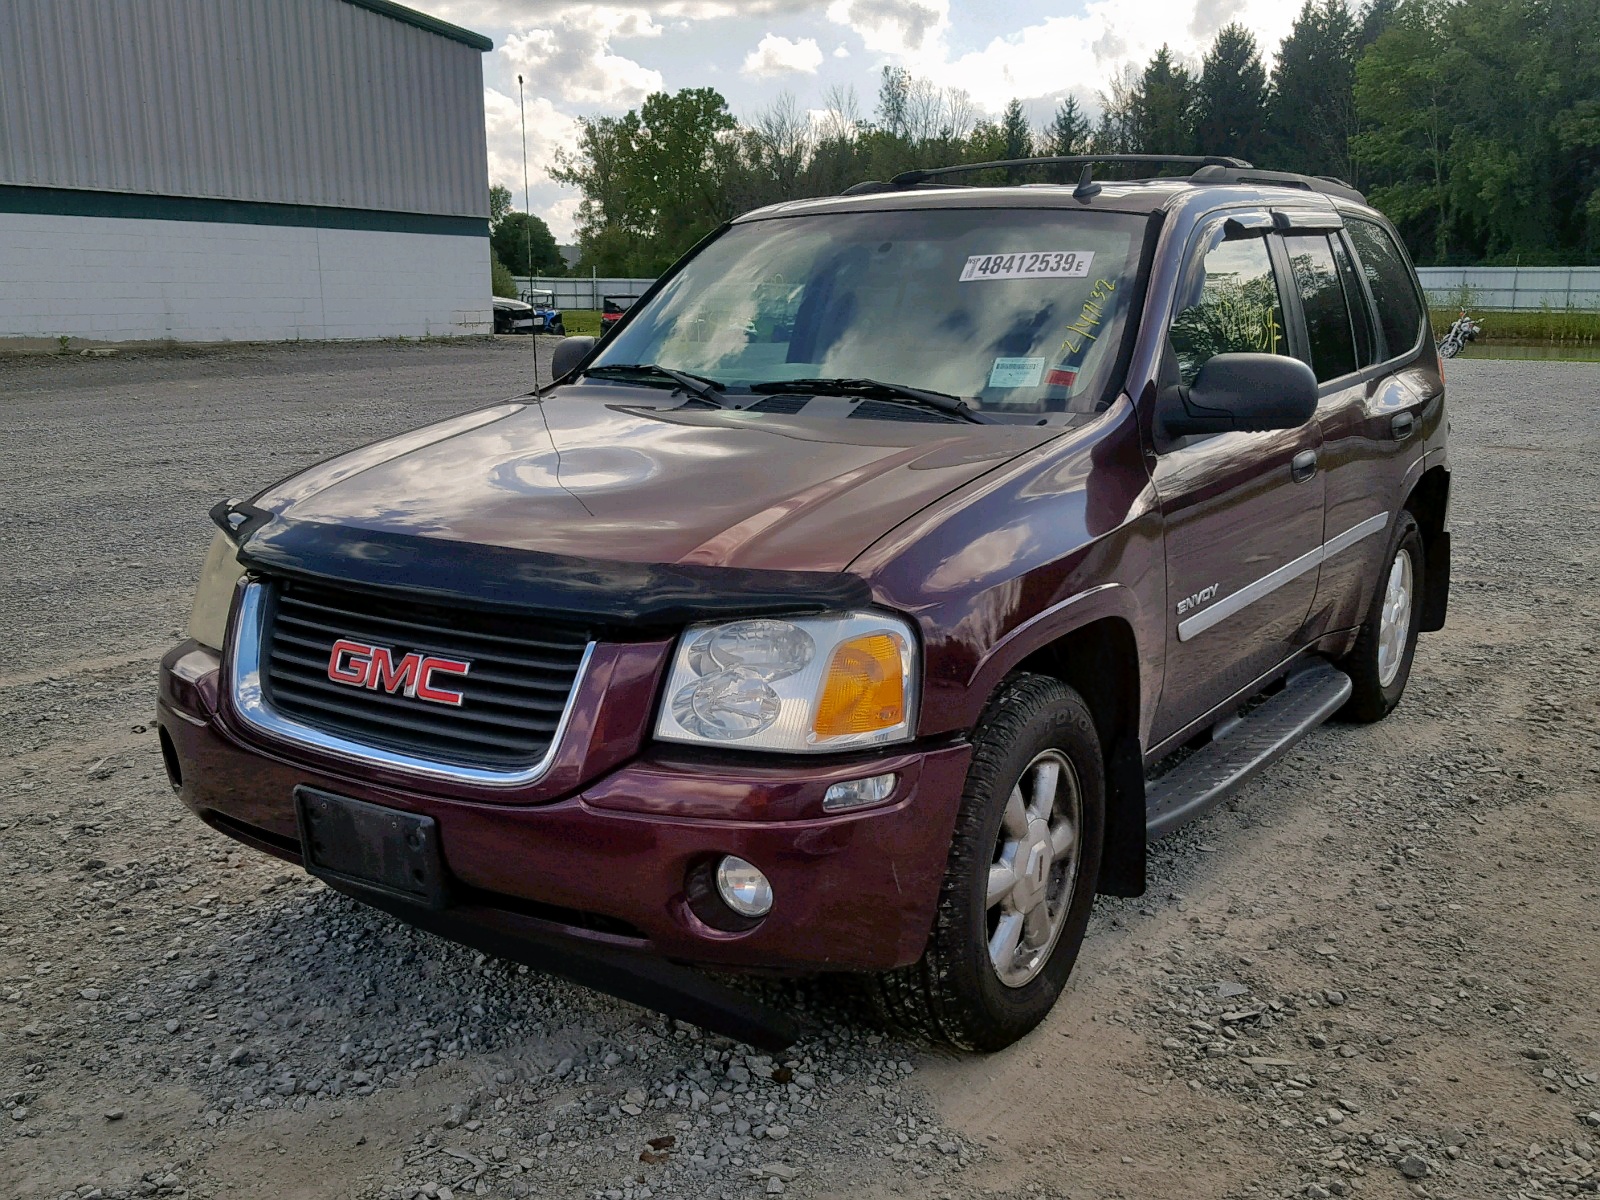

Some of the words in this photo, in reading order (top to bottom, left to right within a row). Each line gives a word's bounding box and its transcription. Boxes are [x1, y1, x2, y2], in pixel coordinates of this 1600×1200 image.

[978, 253, 1076, 275] 48412539
[1177, 582, 1219, 615] ENVOY
[328, 639, 471, 707] GMC
